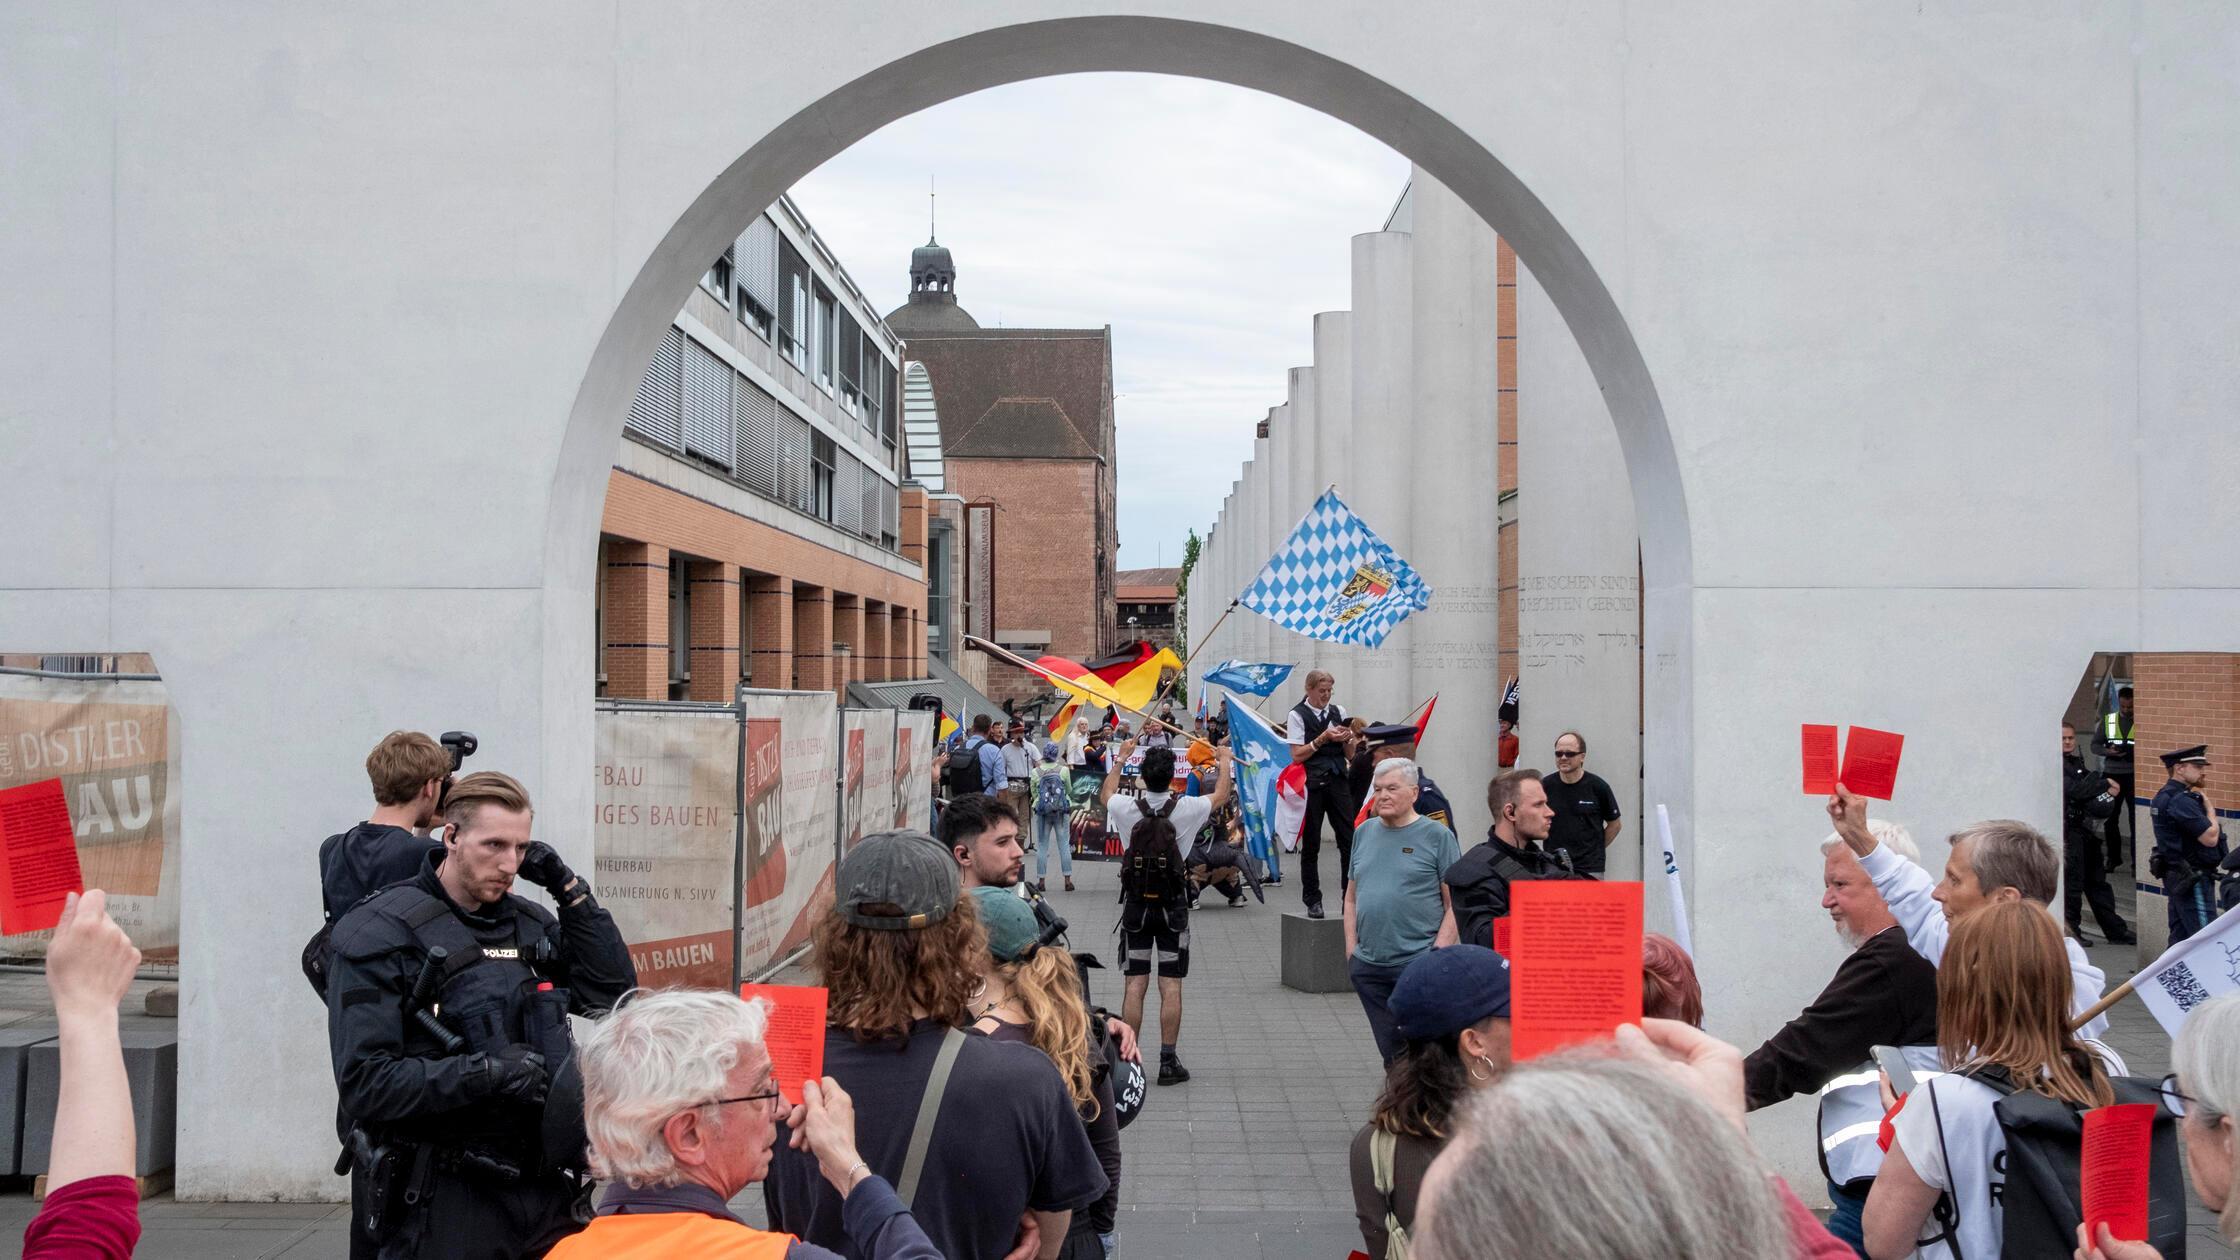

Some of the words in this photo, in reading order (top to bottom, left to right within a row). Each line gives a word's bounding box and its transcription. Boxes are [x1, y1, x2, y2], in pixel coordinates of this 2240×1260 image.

[20, 719, 146, 770] DISTLER
[69, 775, 154, 837] AU
[651, 806, 719, 827] BAUEN
[595, 860, 652, 872] NIEURBAU
[596, 886, 669, 900] NSANIERUNG
[483, 948, 518, 957] POLIZEI
[652, 942, 714, 971] BAUEN
